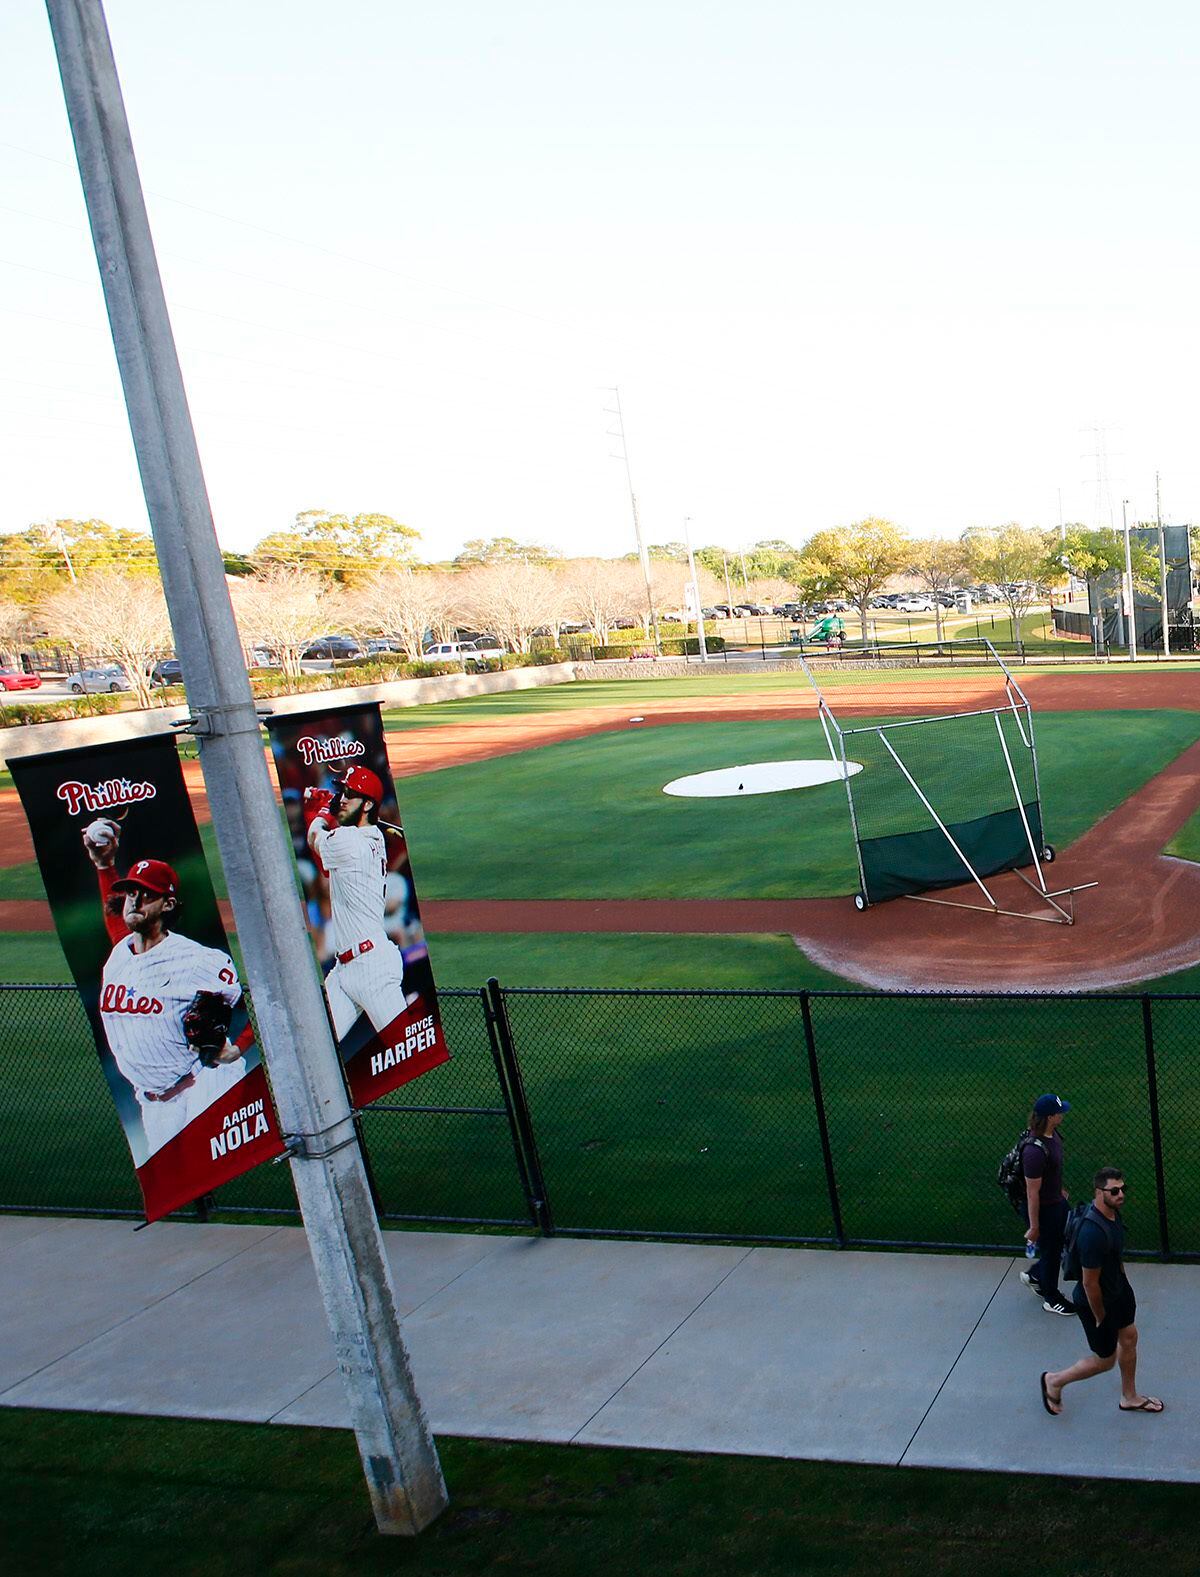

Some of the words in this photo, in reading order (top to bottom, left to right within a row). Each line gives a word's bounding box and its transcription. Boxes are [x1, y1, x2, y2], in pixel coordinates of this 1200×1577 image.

[297, 736, 365, 766] Phillies
[57, 777, 156, 815] Phillies
[136, 860, 150, 875] P
[405, 1014, 434, 1038] BRYCE
[370, 1027, 437, 1076] HARPER
[222, 1098, 264, 1130] AARON
[209, 1113, 270, 1161] NOLA
